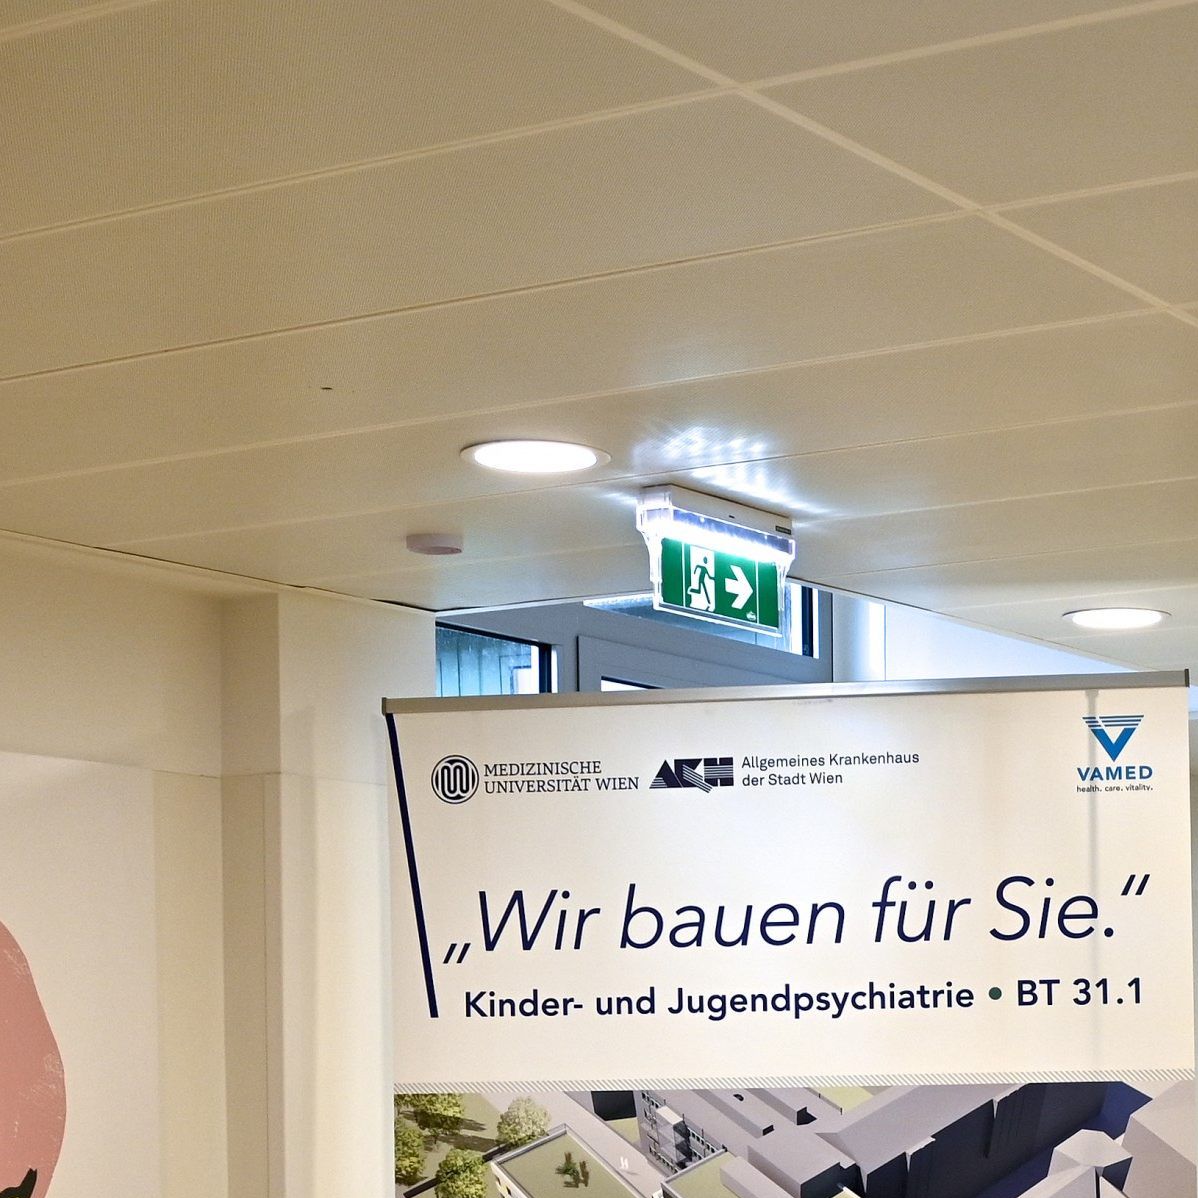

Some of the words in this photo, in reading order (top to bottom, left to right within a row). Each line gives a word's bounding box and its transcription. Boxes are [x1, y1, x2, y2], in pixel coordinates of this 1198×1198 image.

[483, 760, 602, 777] MEDIZINISCHE
[741, 755, 826, 772] Allgemeines
[829, 751, 920, 766] Krankenhaus
[741, 773, 765, 787] der
[768, 772, 806, 786] Stadt
[809, 771, 843, 785] Wien
[1076, 765, 1154, 782] VAMED
[484, 774, 592, 795] UNIVERSITÄT
[595, 776, 640, 791] WIEN
[619, 883, 845, 950] bauen
[871, 875, 972, 943] für
[465, 988, 584, 1018] Kinder-
[596, 986, 656, 1016] und
[667, 981, 975, 1022] Jugendpsychiatrie
[1017, 979, 1061, 1007] BT
[1072, 977, 1141, 1006] 31.1
